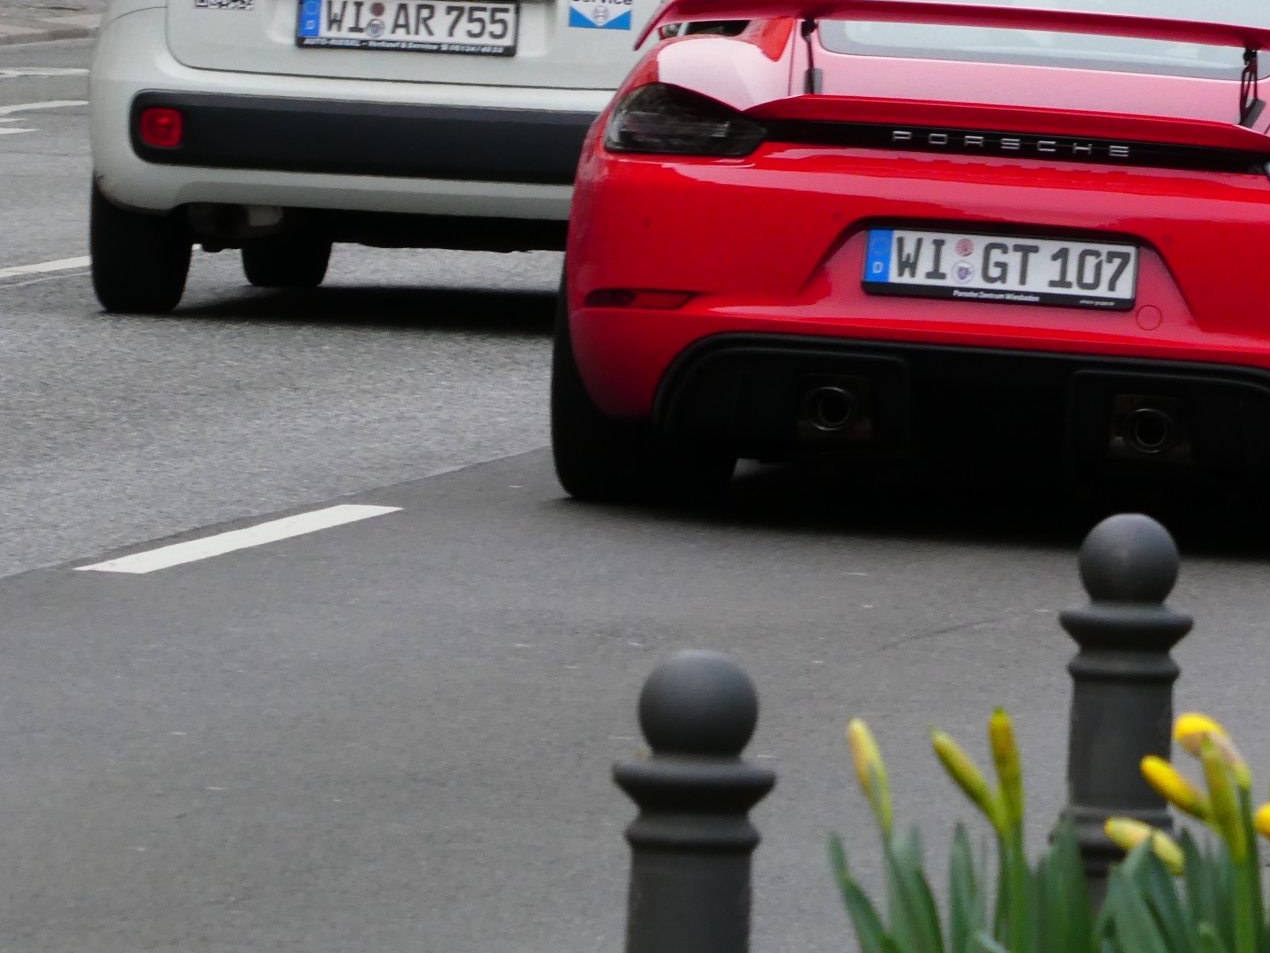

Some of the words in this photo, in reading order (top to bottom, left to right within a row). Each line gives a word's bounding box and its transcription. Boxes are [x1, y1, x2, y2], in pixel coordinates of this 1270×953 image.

[326, 0, 365, 33] WI
[390, 3, 435, 36] AR
[445, 5, 510, 40] 755
[892, 130, 1130, 157] PORSCHE
[896, 236, 946, 280] WI
[981, 242, 1039, 286] GT
[1048, 247, 1132, 292] 107
